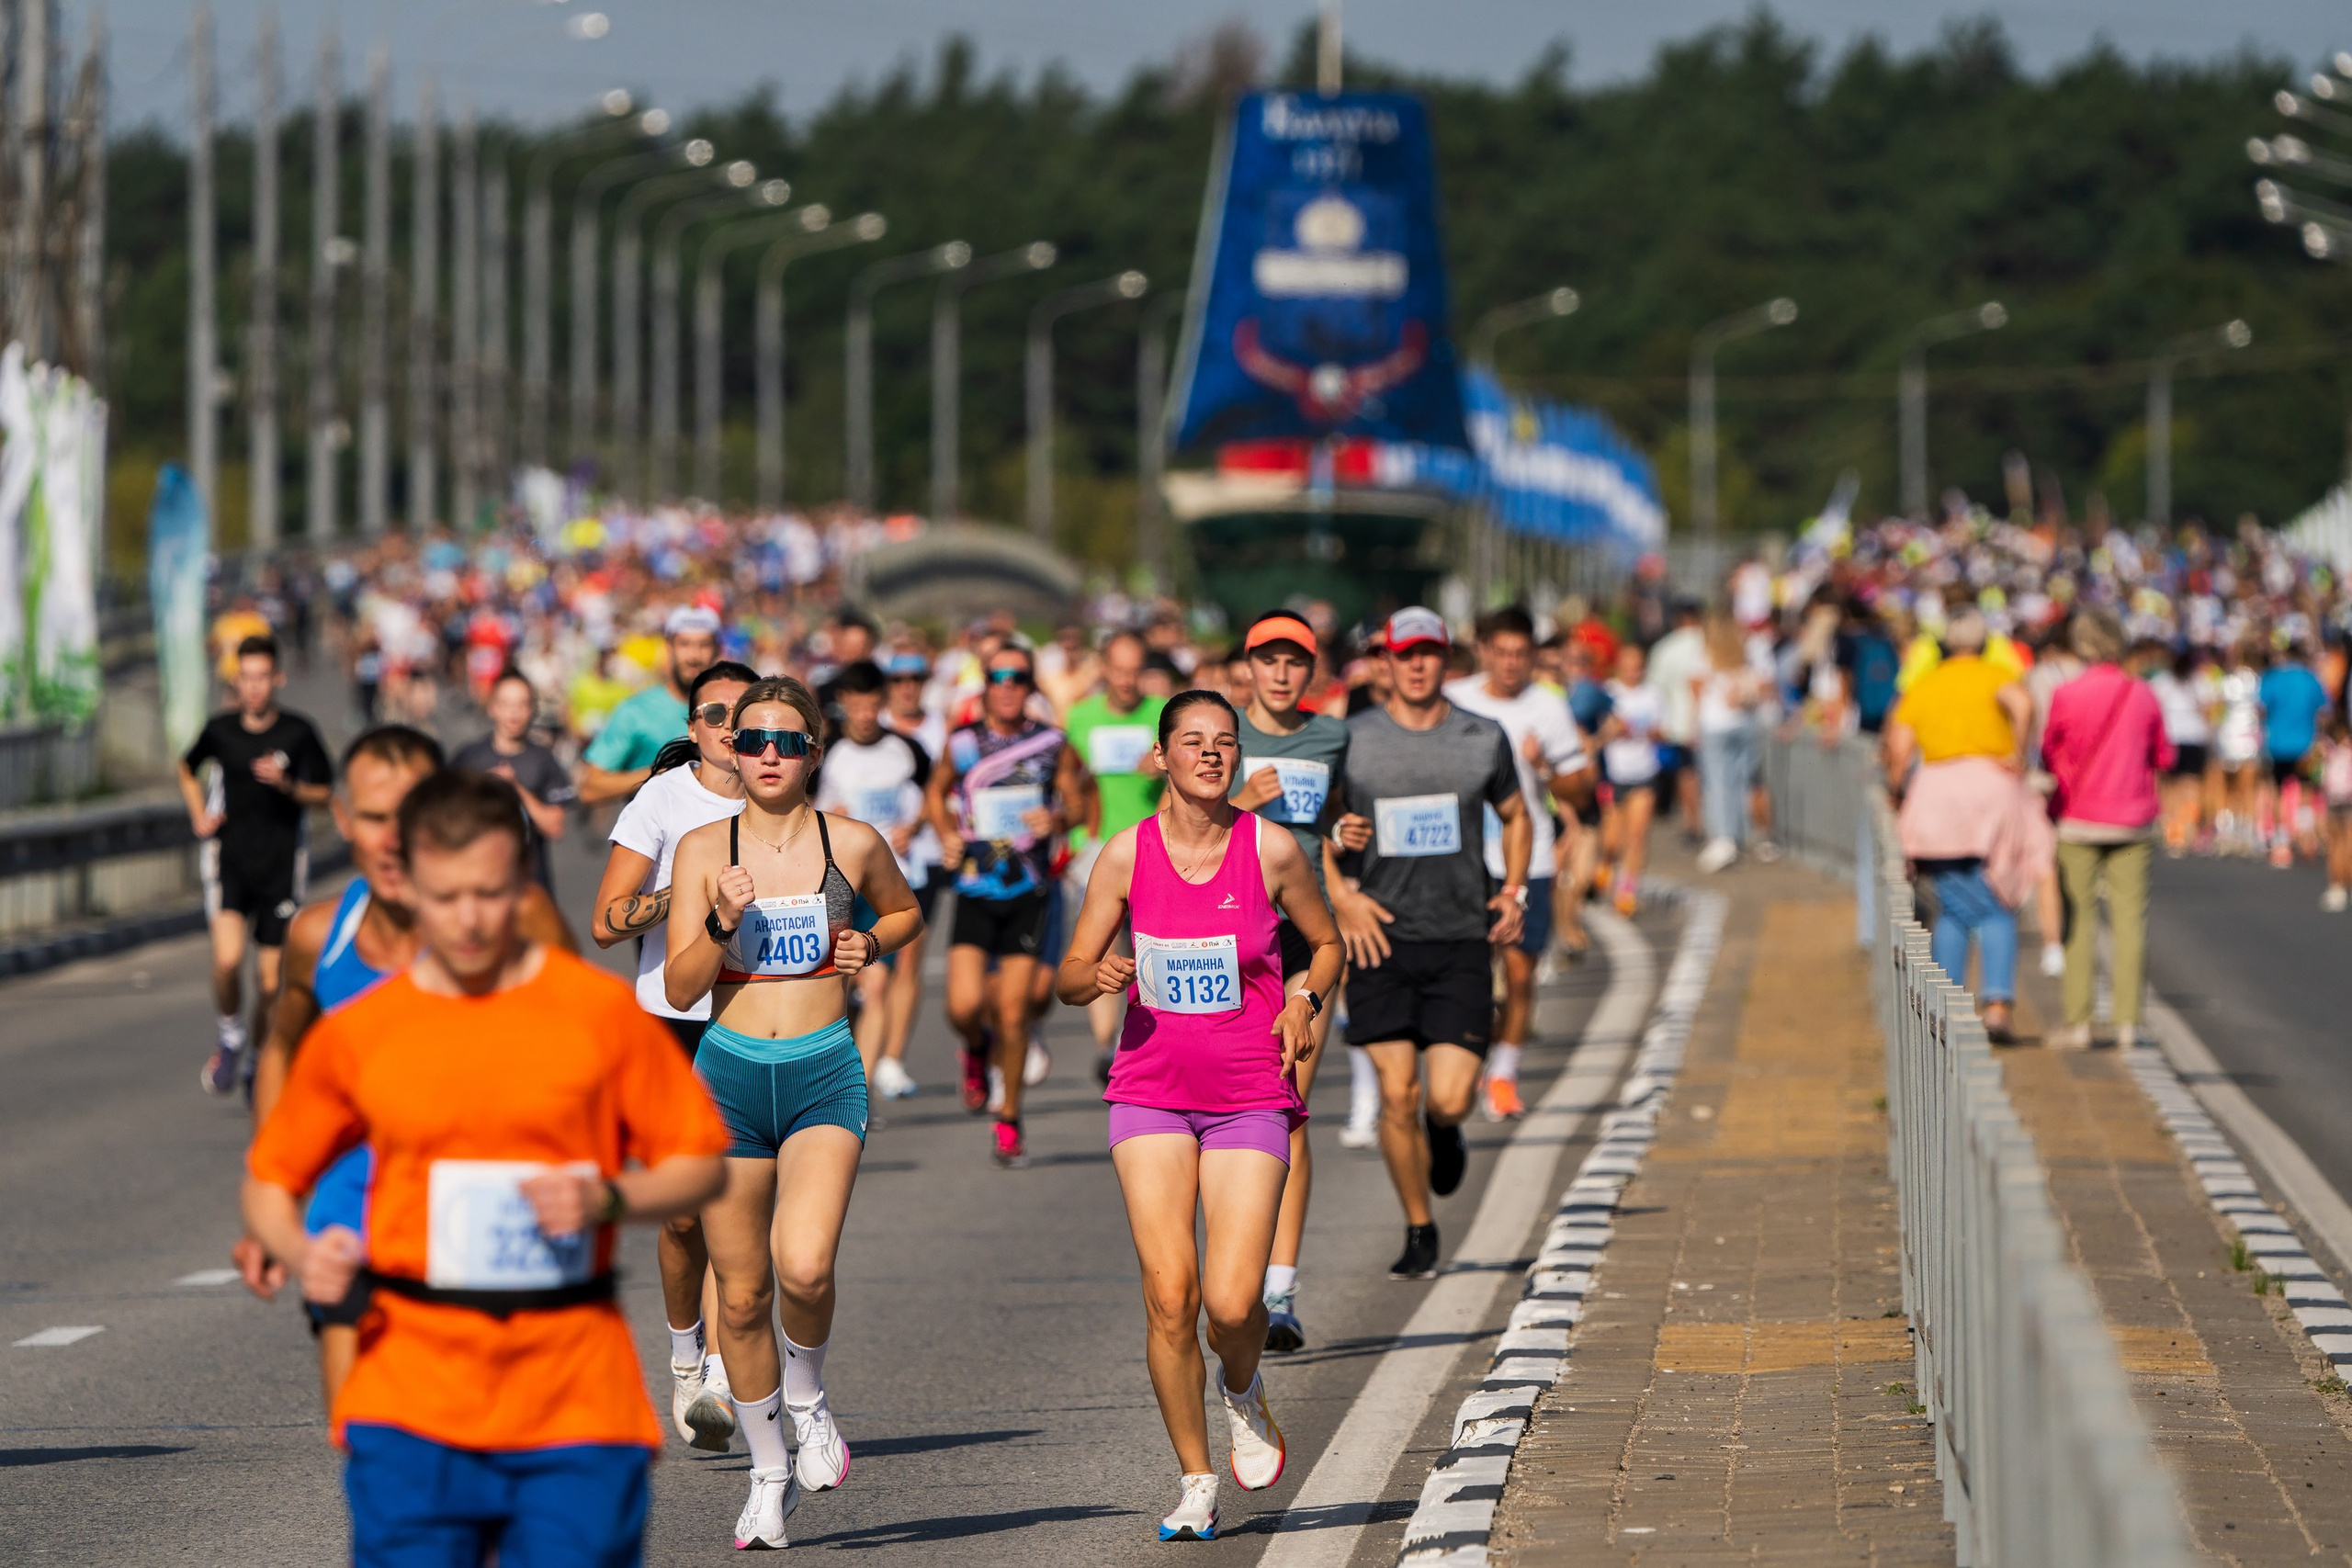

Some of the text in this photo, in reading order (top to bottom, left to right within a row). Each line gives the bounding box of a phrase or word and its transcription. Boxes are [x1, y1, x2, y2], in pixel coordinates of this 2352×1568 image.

[754, 915, 816, 933] АНАСТАСИЯ
[756, 933, 820, 966] 4403
[1167, 957, 1225, 971] МАРИАННА
[1167, 974, 1231, 1004] 3132
